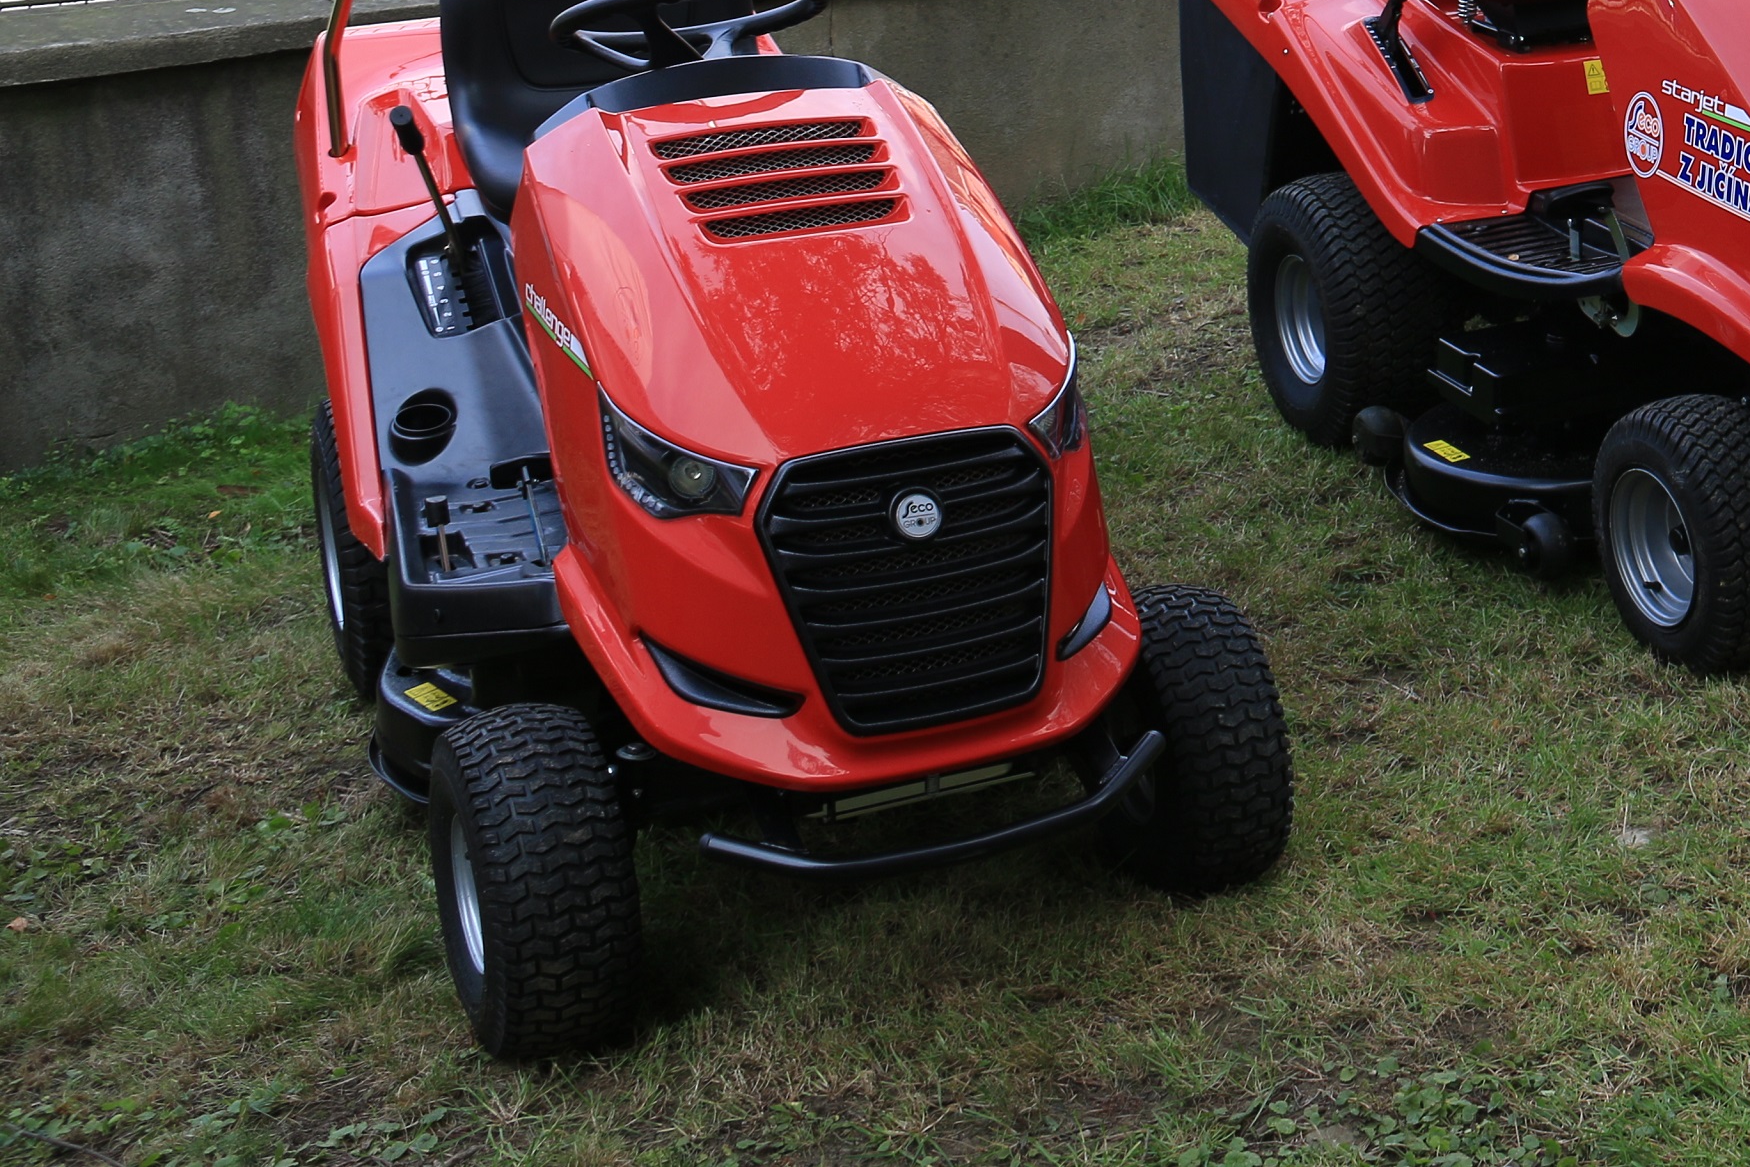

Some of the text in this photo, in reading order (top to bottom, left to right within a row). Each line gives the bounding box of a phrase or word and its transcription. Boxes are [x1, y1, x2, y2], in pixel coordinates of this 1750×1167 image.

[1661, 79, 1726, 117] starjet
[1628, 100, 1661, 138] Seco
[1627, 134, 1660, 164] GROUP
[1677, 151, 1695, 186] Z
[525, 283, 571, 348] challenge
[902, 500, 934, 519] Seco
[903, 516, 937, 529] GROUP
